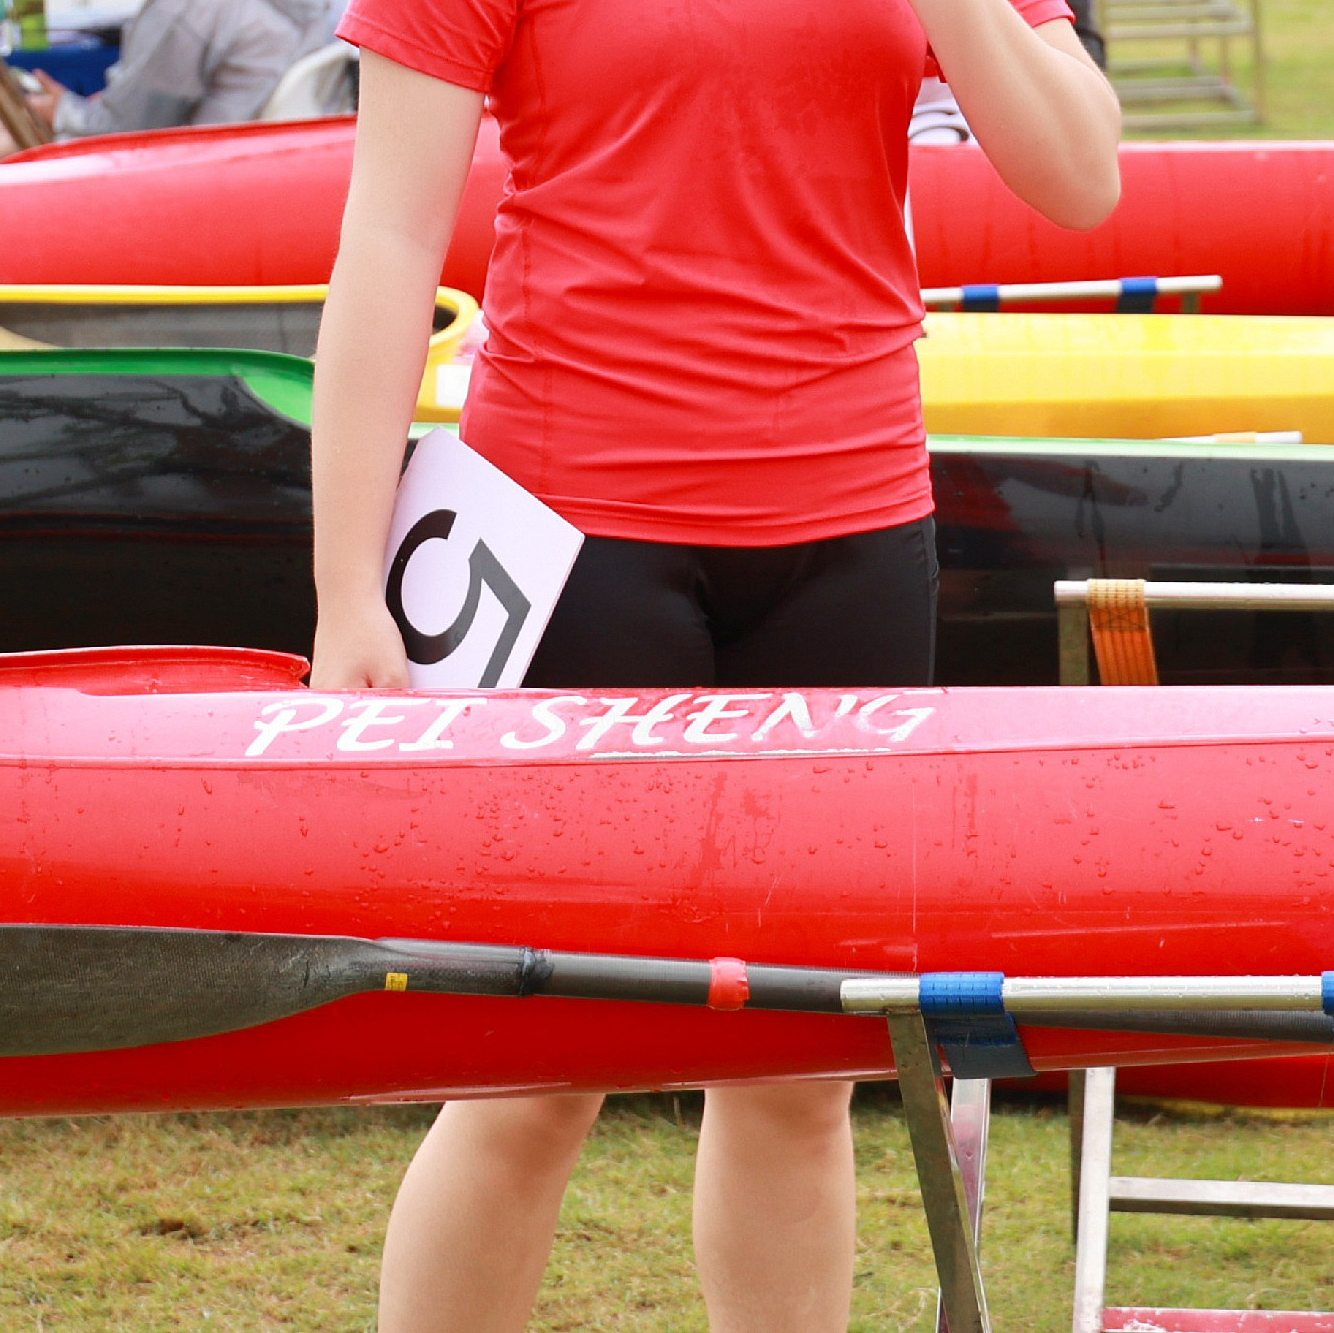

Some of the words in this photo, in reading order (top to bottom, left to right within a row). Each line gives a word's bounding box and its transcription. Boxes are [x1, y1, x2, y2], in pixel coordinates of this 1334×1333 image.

[385, 508, 533, 688] 5
[244, 696, 489, 757] PEI
[500, 689, 940, 751] SHENG
